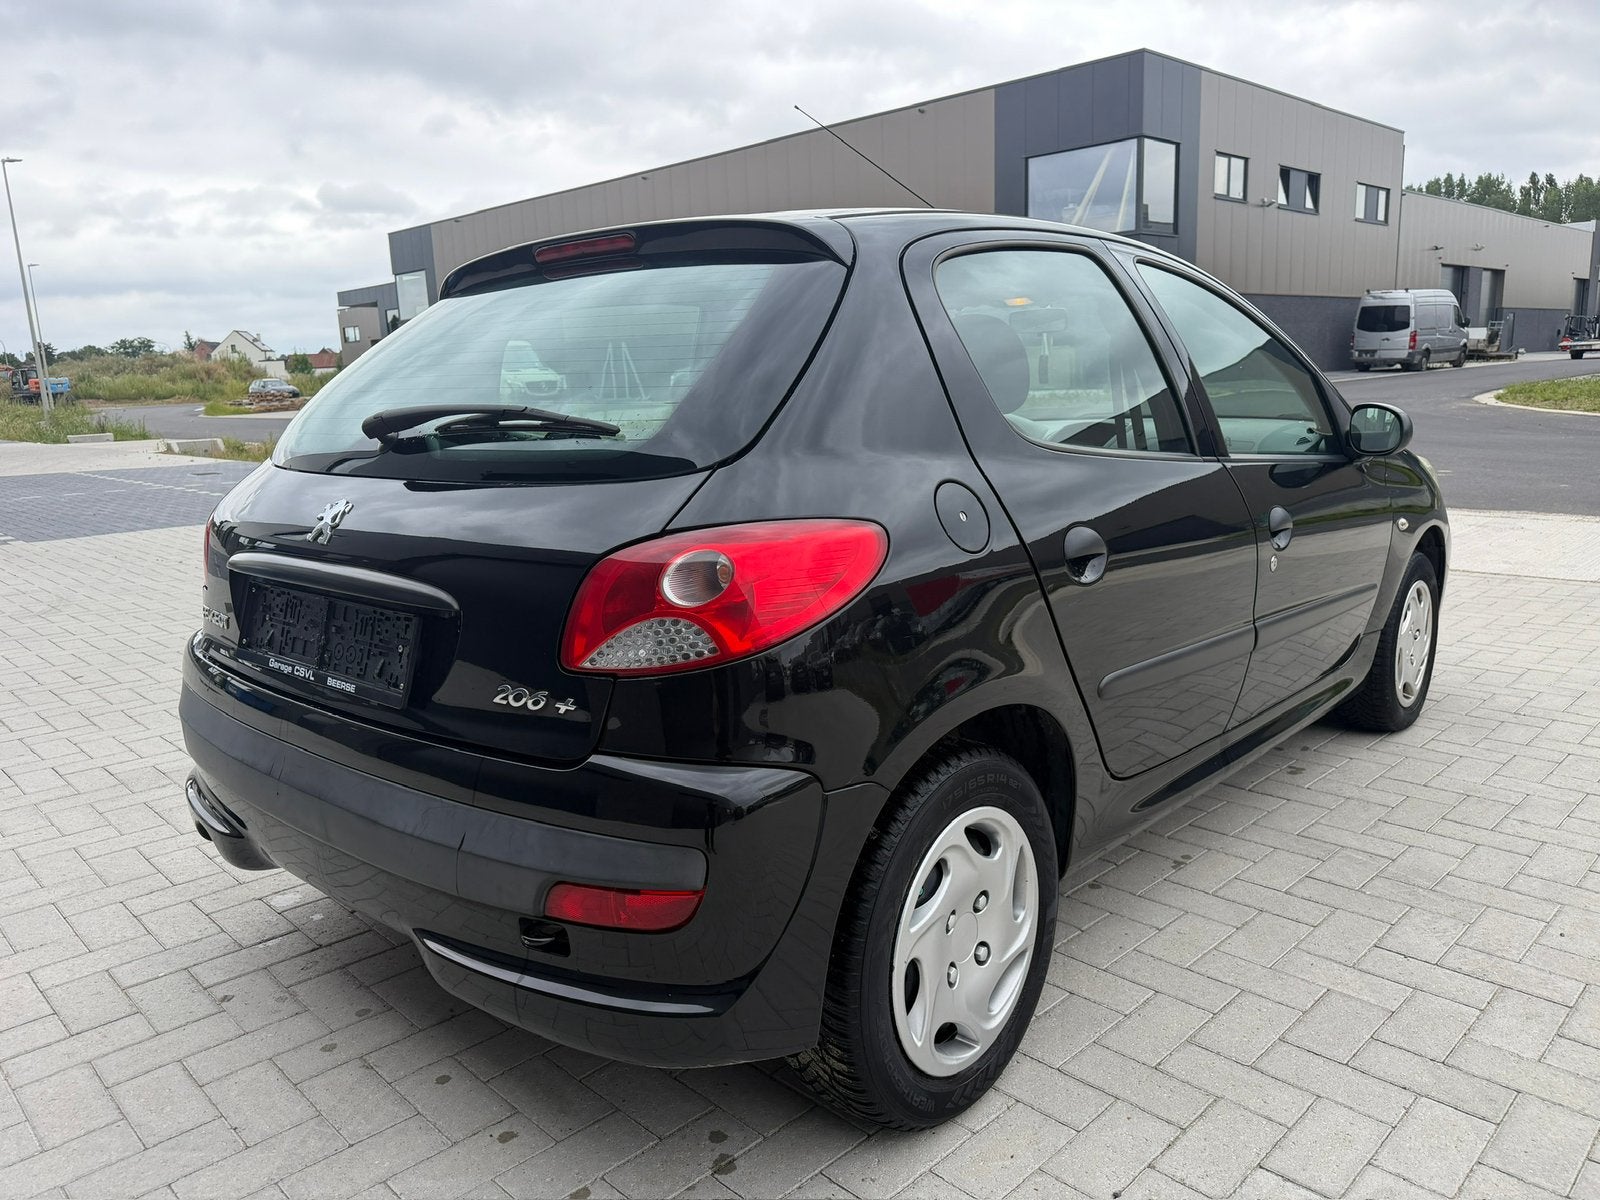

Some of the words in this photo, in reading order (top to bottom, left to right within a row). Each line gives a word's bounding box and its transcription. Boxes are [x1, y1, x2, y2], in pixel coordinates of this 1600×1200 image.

[268, 658, 293, 674] Garage
[293, 665, 315, 681] CSVL
[326, 676, 356, 693] BEERSE
[493, 684, 549, 711] 206
